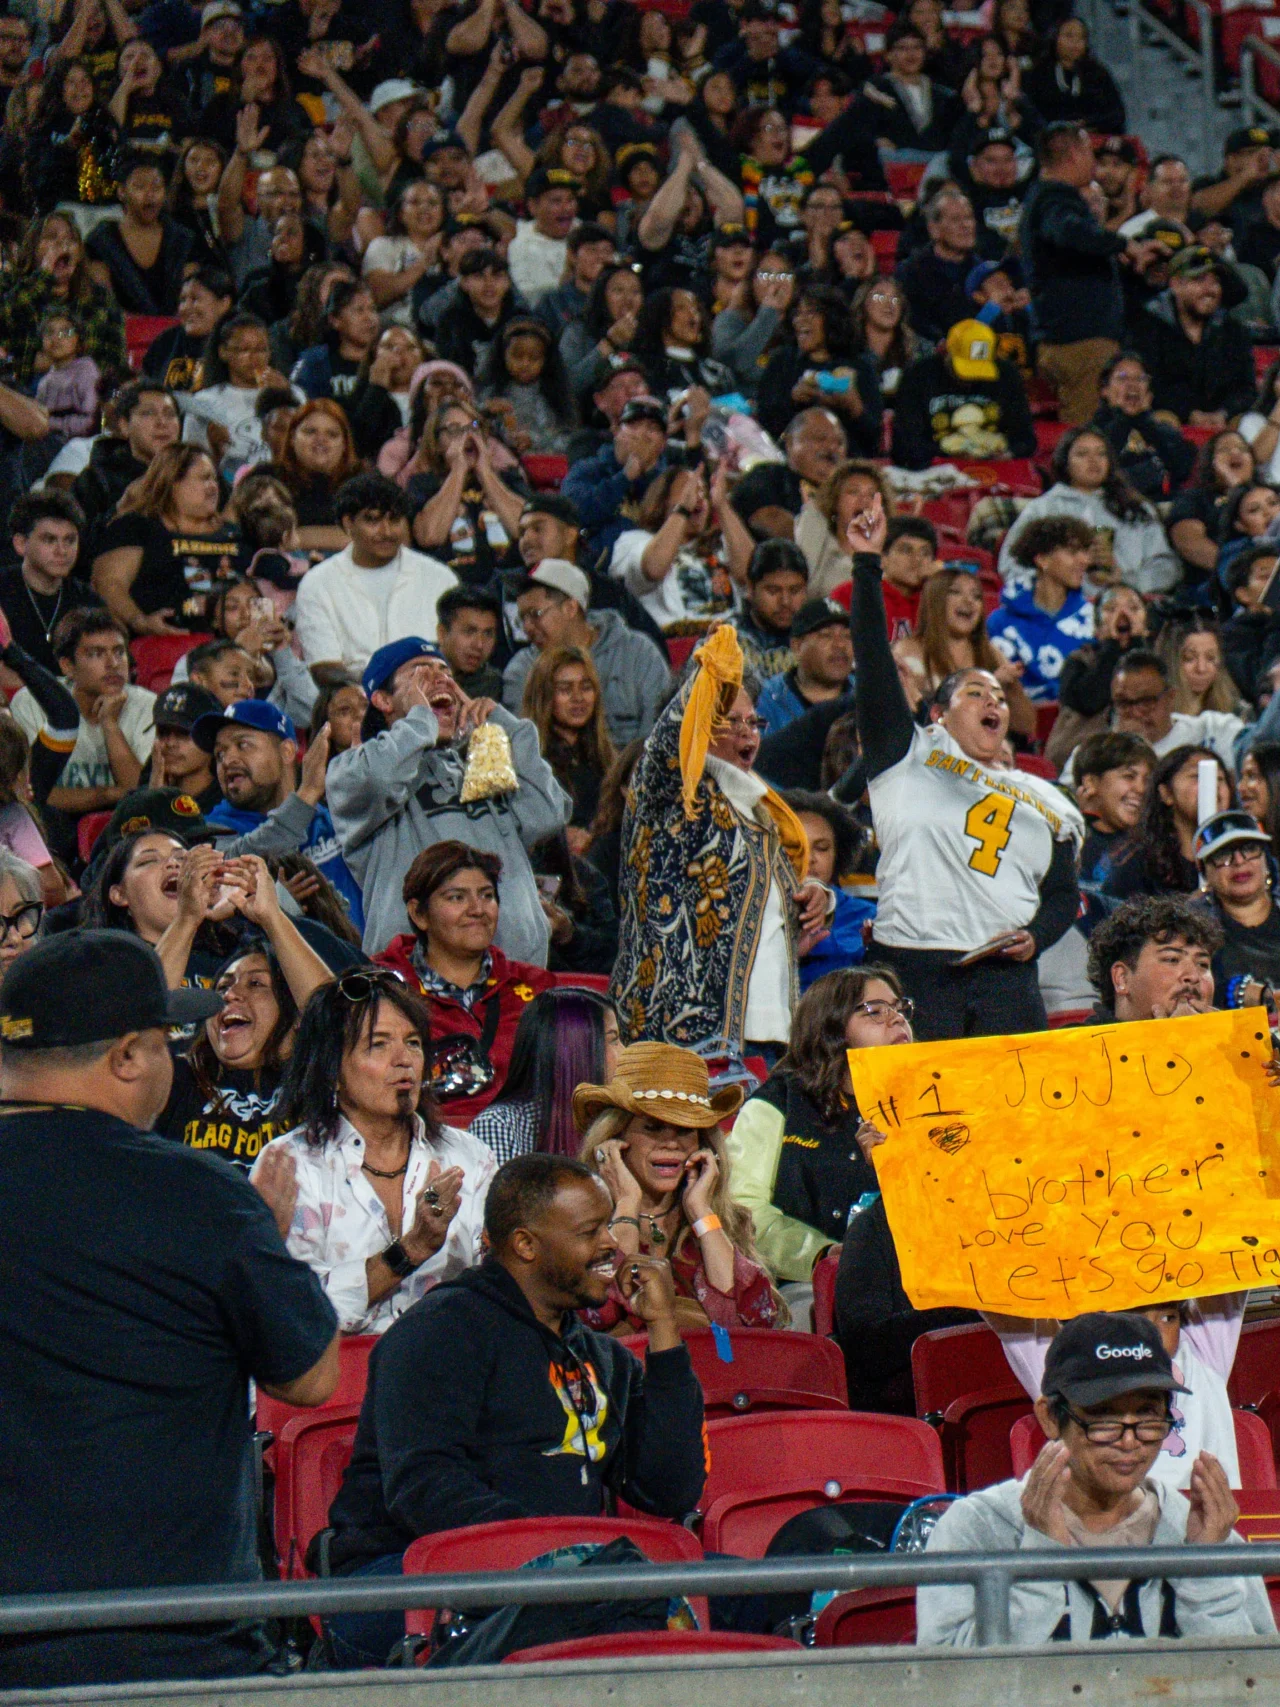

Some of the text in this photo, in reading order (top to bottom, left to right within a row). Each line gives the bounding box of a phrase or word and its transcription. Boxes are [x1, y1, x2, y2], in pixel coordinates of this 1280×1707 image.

[924, 748, 973, 778] SAN
[964, 792, 1013, 878] 4
[183, 1119, 233, 1150] FLAG
[1135, 1252, 1205, 1294] go
[1096, 1343, 1153, 1361] Google
